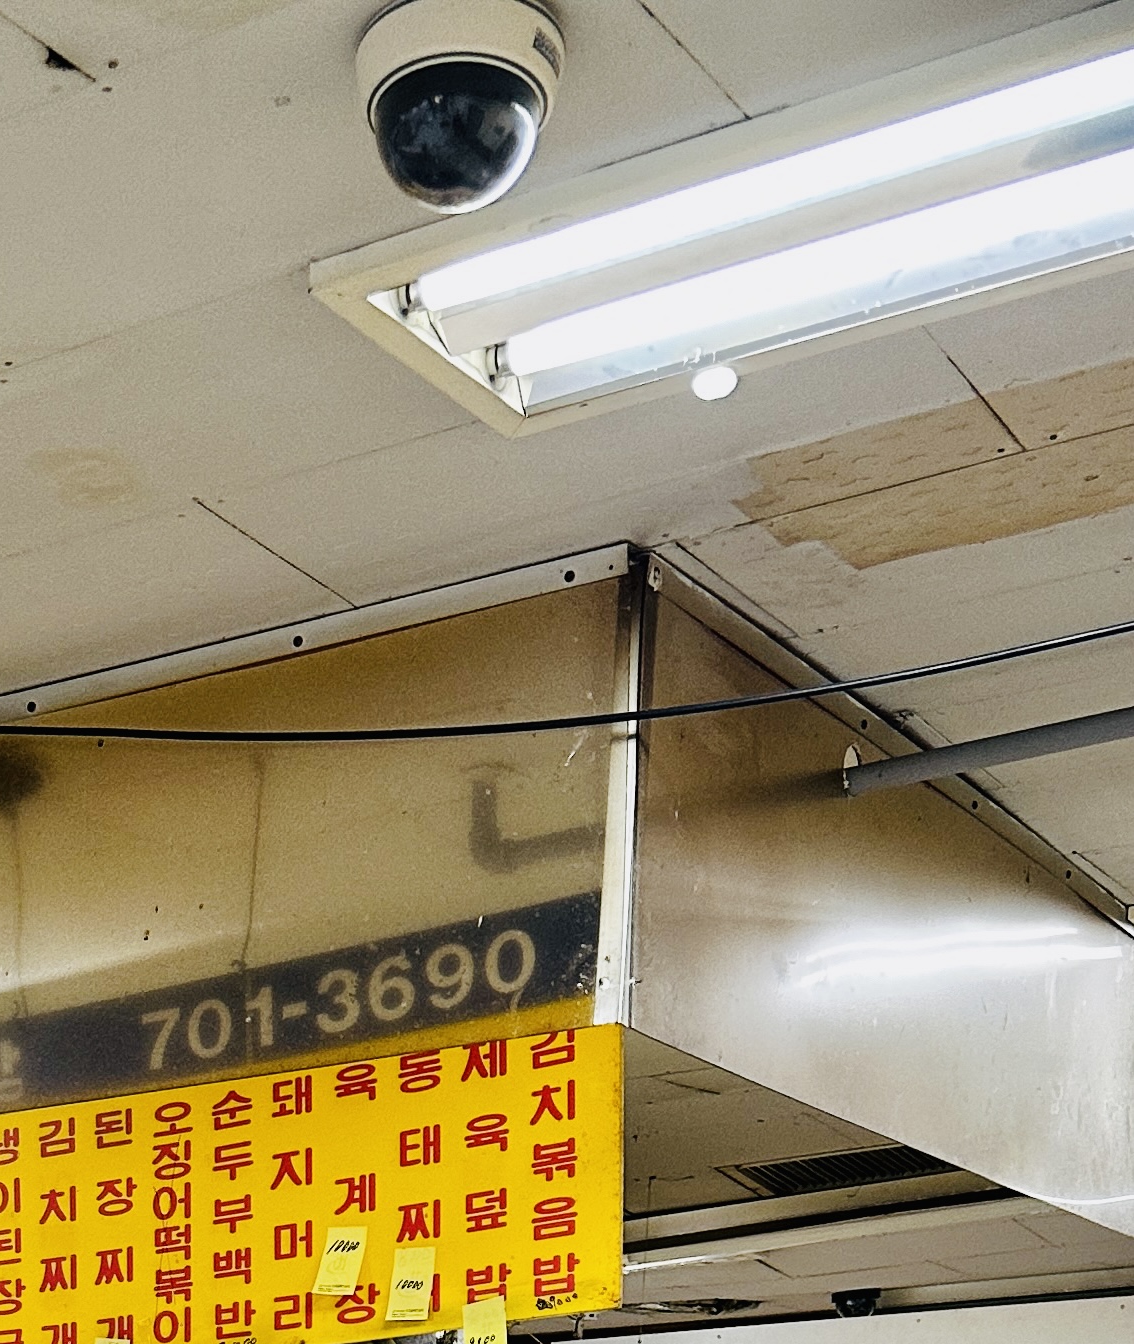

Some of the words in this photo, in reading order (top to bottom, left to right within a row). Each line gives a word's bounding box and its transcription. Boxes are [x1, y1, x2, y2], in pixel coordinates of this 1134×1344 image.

[139, 929, 537, 1070] 701-3690
[152, 1101, 194, 1343] 오징어떡볶이
[212, 1090, 256, 1340] 순두부백반
[271, 1075, 314, 1331] 돼지머리
[334, 1063, 381, 1325] 육계장
[397, 1053, 442, 1312] 동태찌
[530, 1031, 580, 1297] 김치볶음밥
